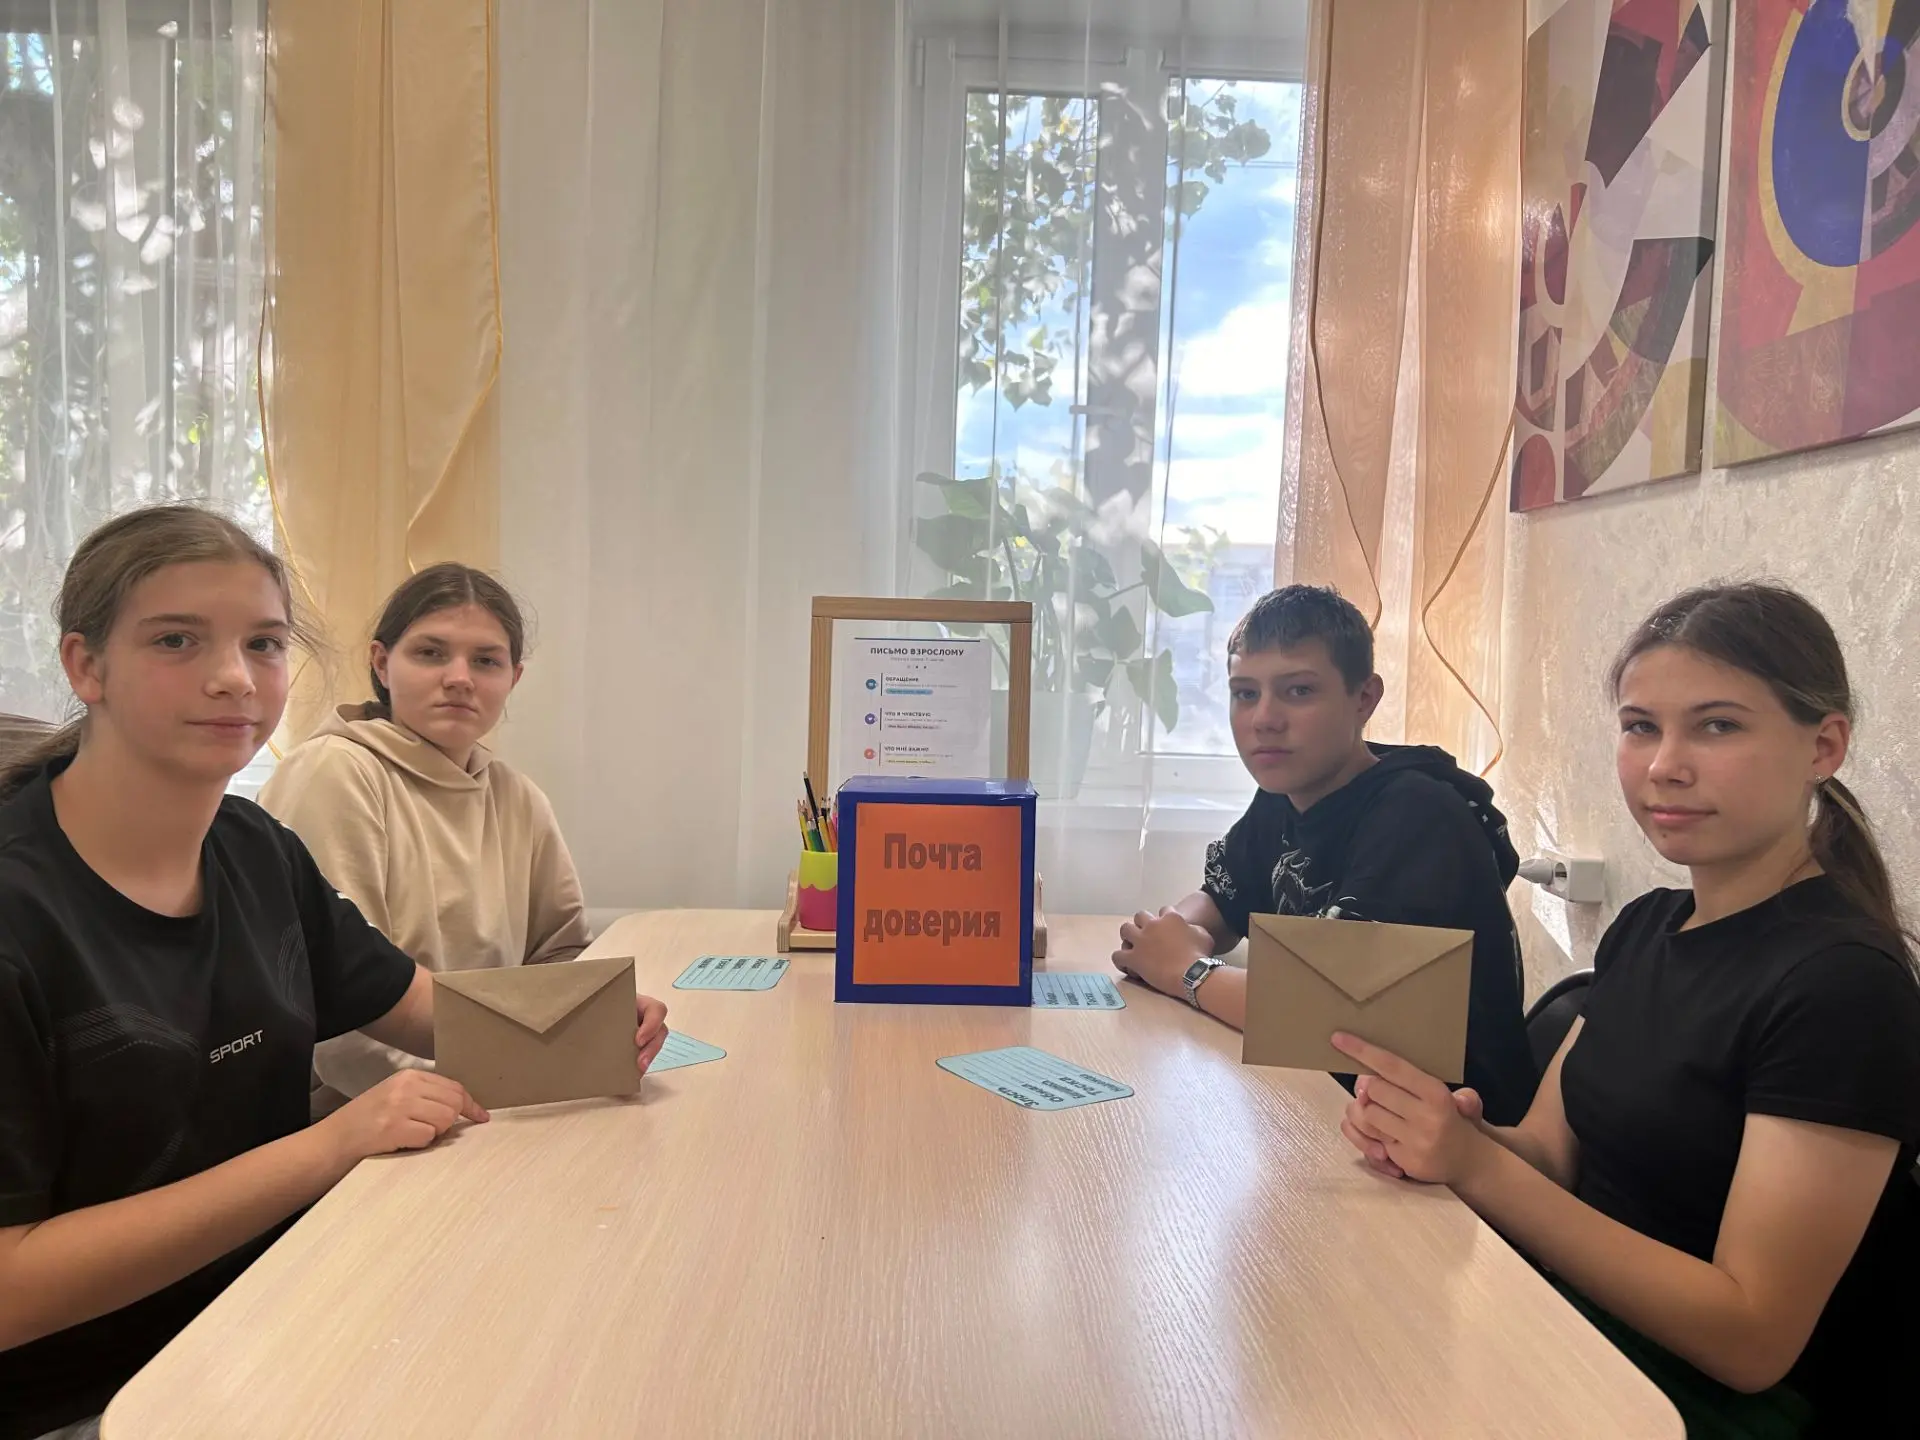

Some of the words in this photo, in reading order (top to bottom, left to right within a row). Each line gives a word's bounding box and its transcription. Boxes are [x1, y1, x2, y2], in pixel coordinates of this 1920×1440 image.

[870, 647, 908, 655] ПИСЬМО
[910, 647, 964, 656] ВЗРОСЛОМУ
[884, 832, 982, 872] Почта
[863, 908, 1001, 946] доверия
[209, 1029, 263, 1064] SPORT
[998, 1086, 1040, 1107] Злость
